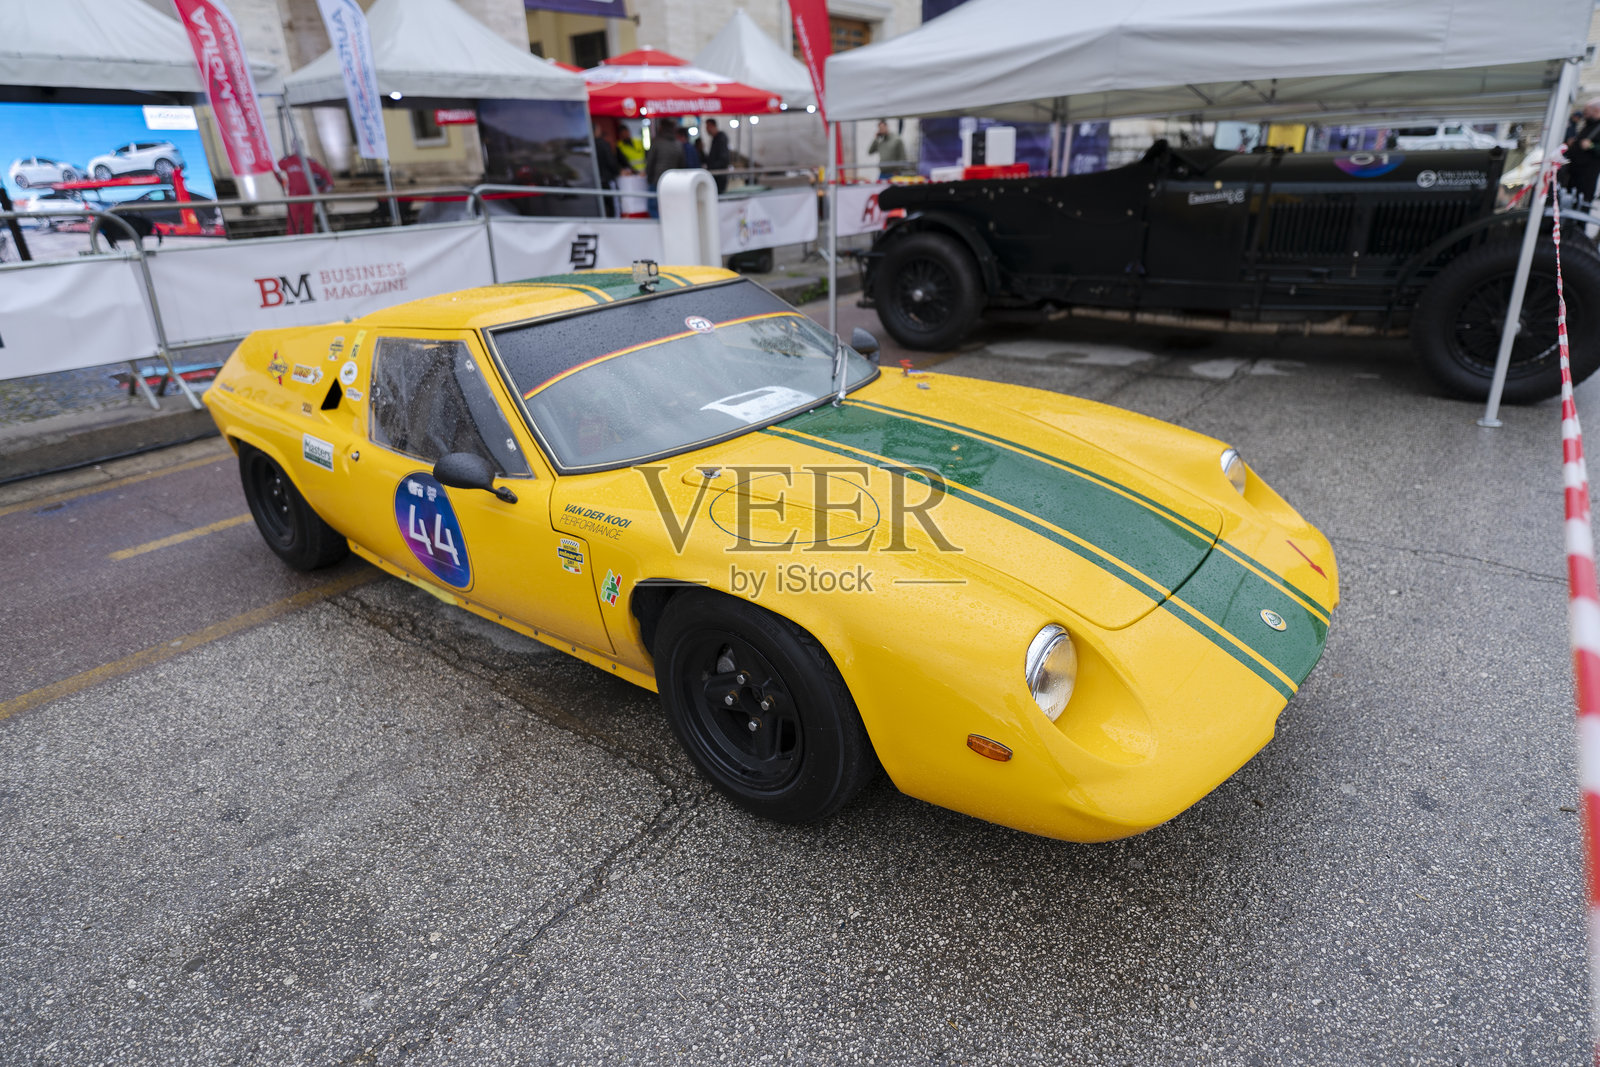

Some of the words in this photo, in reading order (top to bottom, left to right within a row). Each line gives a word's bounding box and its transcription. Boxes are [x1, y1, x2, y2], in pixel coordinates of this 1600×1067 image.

[320, 262, 407, 285] BUSINESS
[254, 273, 317, 308] BM
[324, 277, 409, 300] MAGAZINE
[560, 513, 624, 541] PERFORMANCE
[564, 503, 584, 516] VAN
[583, 508, 605, 521] DER
[604, 514, 632, 528] KOOI
[409, 503, 461, 567] 44
